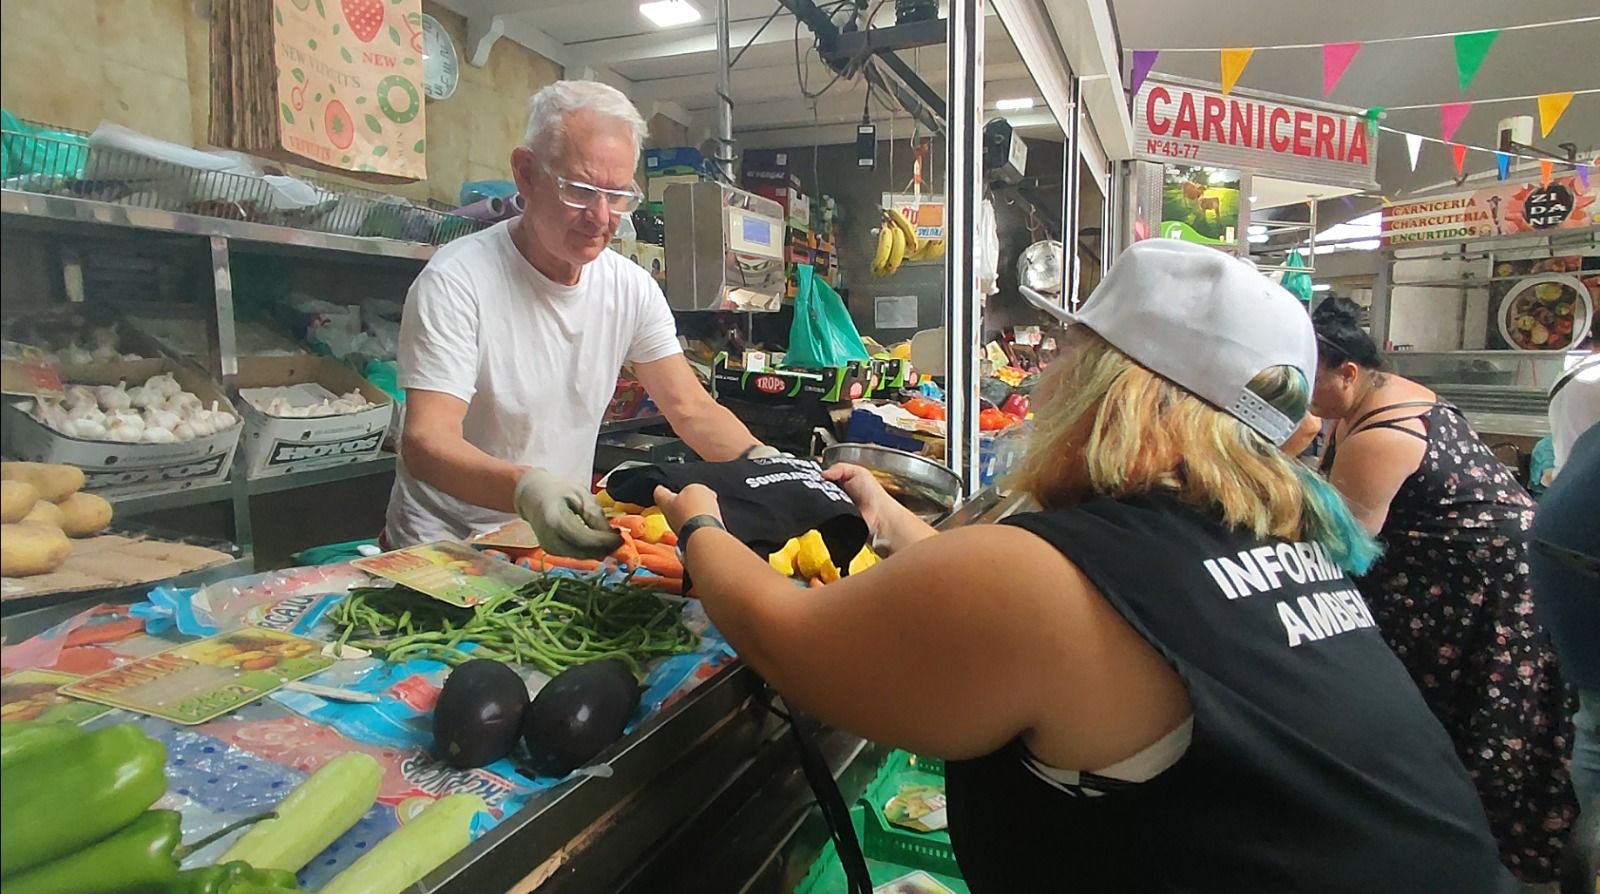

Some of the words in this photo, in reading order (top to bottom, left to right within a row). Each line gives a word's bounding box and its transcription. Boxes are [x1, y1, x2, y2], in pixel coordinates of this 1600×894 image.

[362, 52, 397, 68] NEW
[1145, 86, 1369, 166] CARNICERIA
[1531, 192, 1557, 204] ZI
[1393, 198, 1476, 216] CARNICERIA
[1530, 203, 1567, 215] DA
[1391, 211, 1489, 230] CHARCUTERIA
[1529, 215, 1562, 226] NE
[1391, 226, 1476, 244] ENCURTIDOS
[756, 377, 786, 391] TROPS
